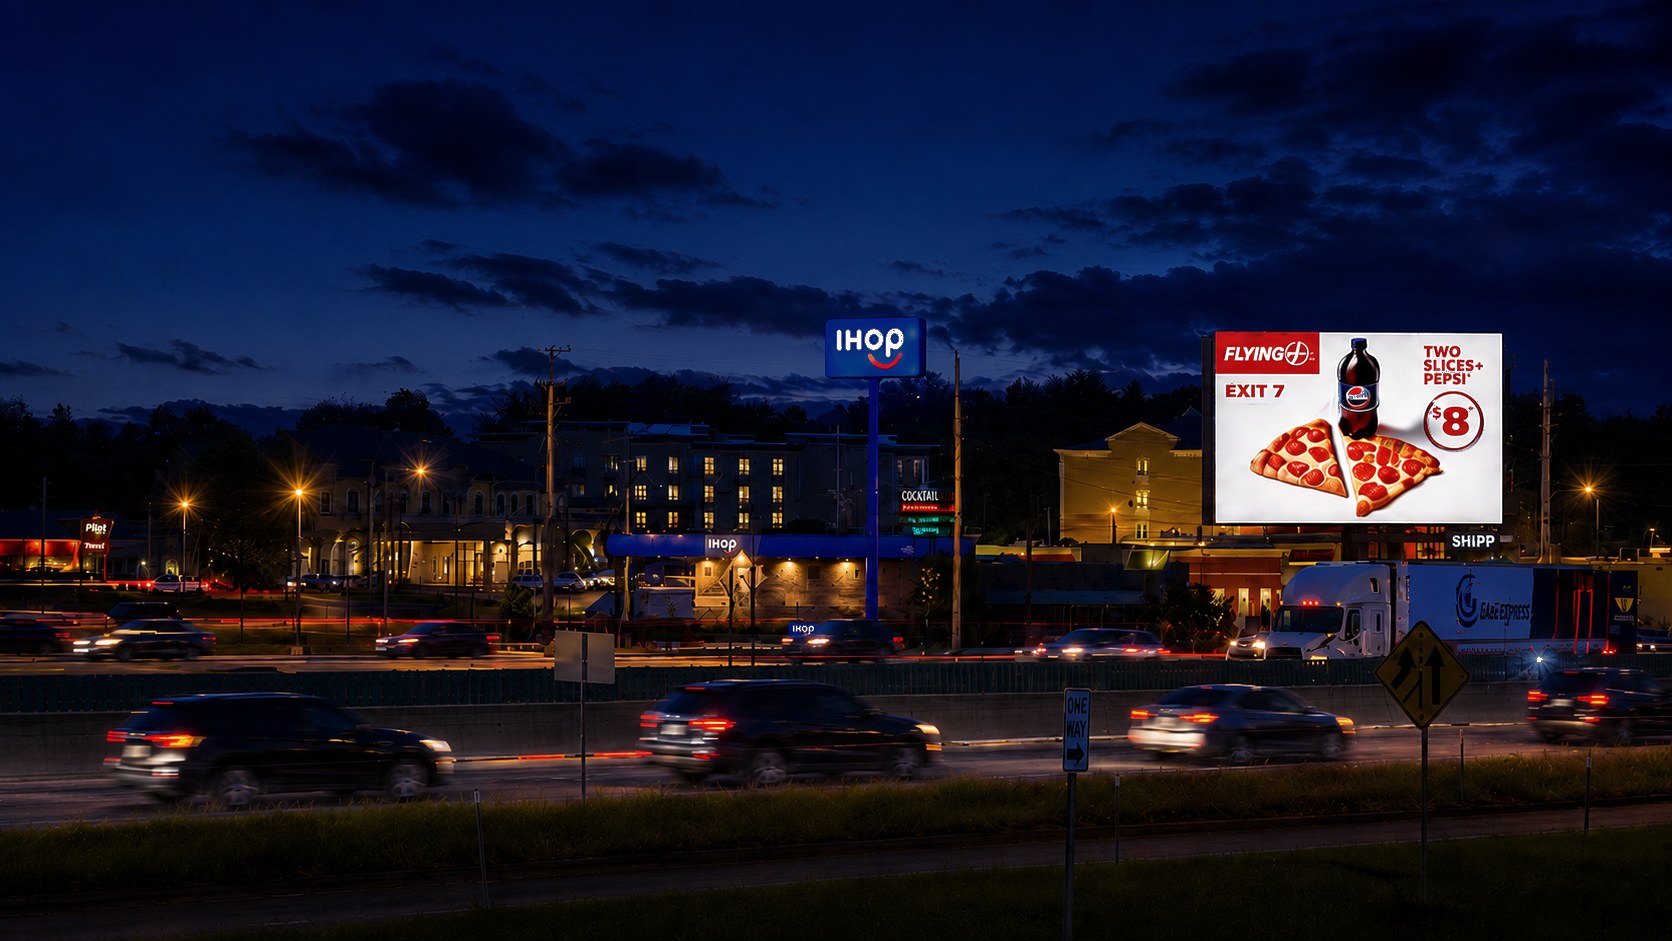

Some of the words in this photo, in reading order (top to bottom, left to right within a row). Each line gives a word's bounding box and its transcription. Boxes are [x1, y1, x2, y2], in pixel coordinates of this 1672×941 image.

[1223, 346, 1285, 361] FLYING
[1423, 345, 1461, 358] TWO
[1225, 383, 1268, 398] EXIT
[1272, 384, 1286, 398] 7
[901, 490, 939, 502] COCKTAIL
[1452, 534, 1495, 548] SHIPP
[1067, 696, 1088, 714] ONE
[1066, 720, 1087, 738] WAY
